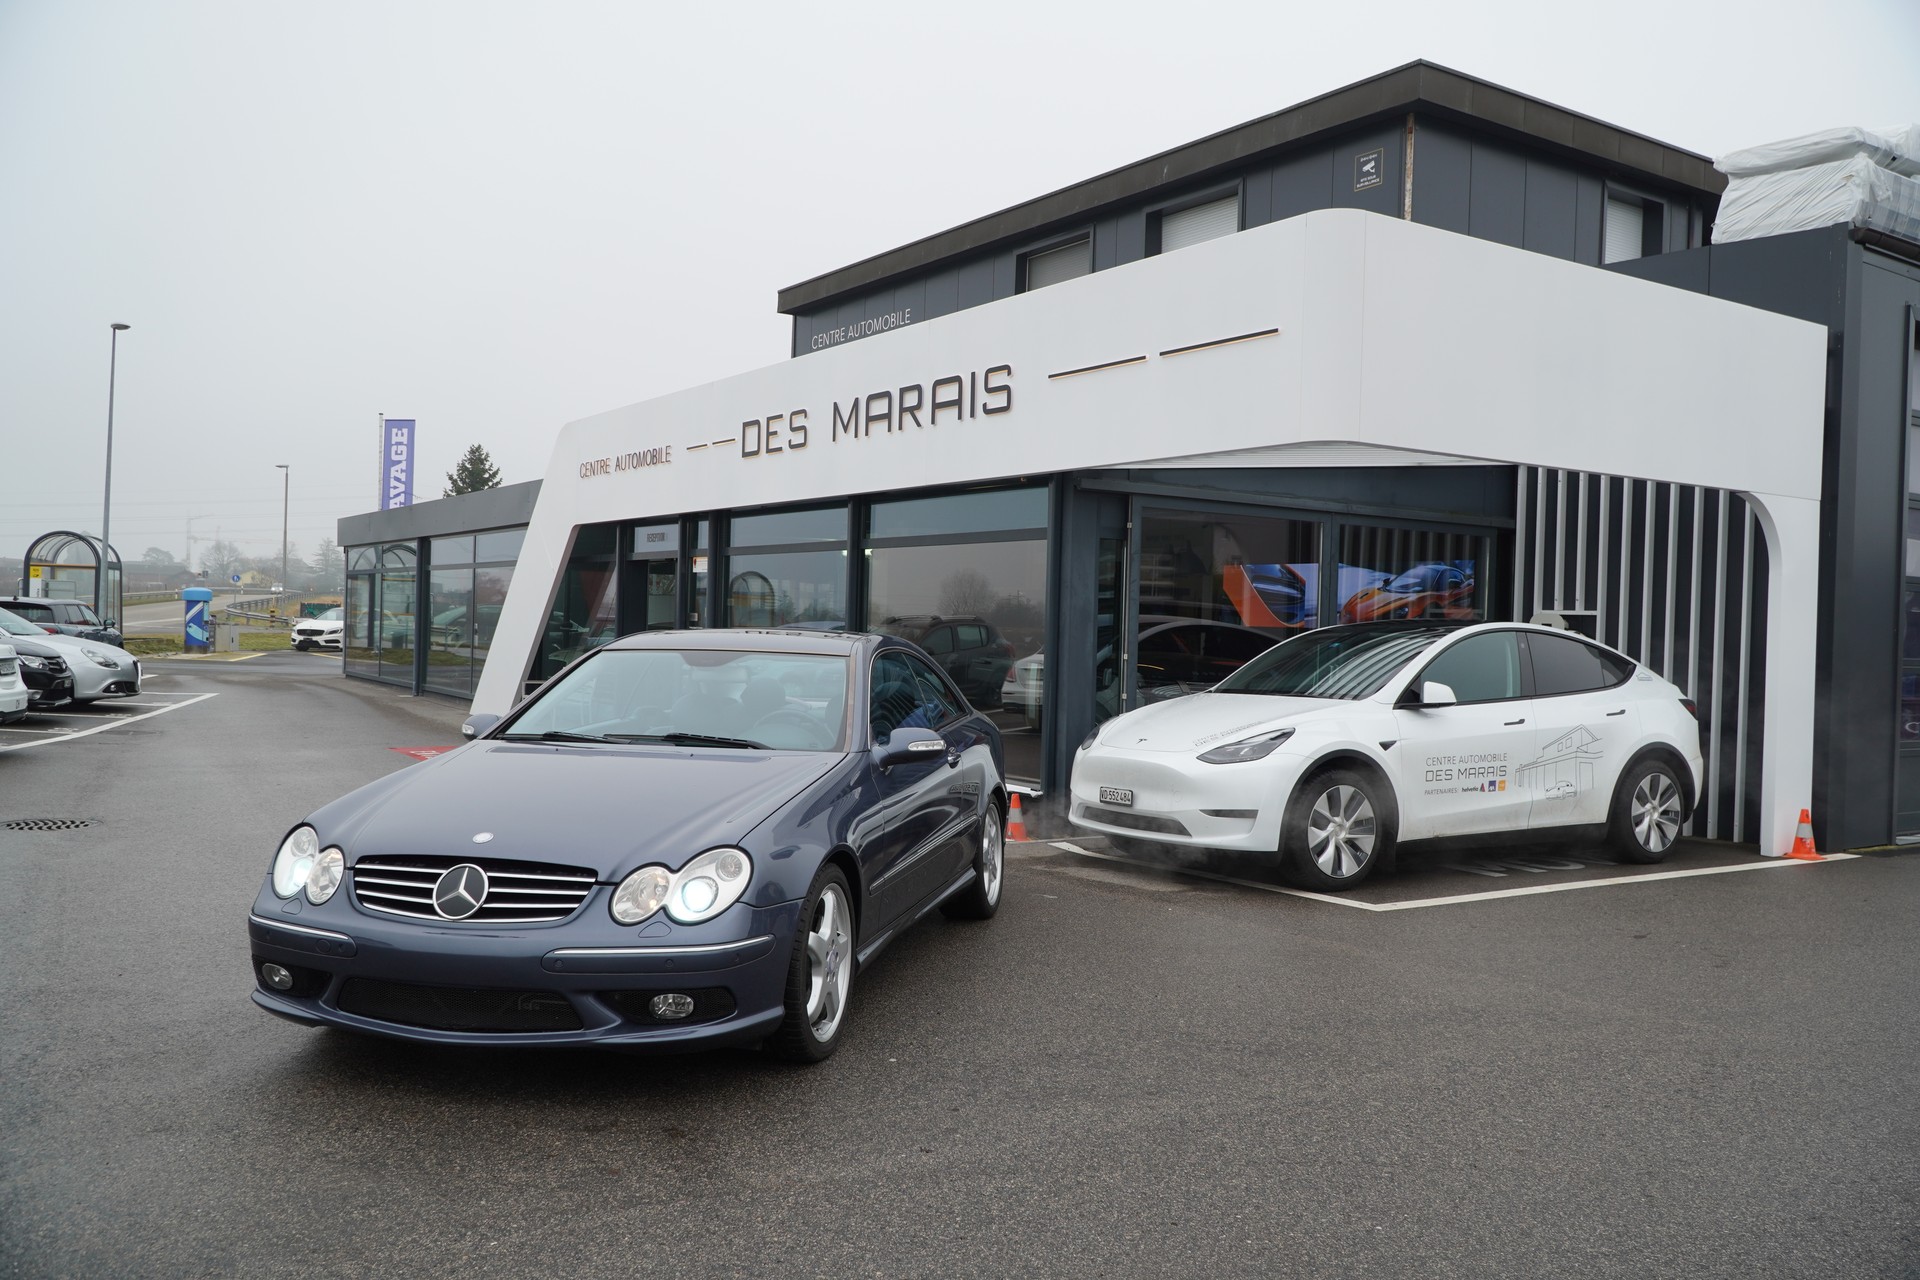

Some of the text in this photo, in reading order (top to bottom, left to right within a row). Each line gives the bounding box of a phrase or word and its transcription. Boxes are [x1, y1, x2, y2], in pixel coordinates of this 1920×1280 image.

[811, 308, 912, 350] CENTRE AUTOMOBILE
[579, 364, 1013, 479] CENTRE AUTOMOBILE DES MARAIS
[389, 428, 408, 509] AVAGE
[1425, 752, 1508, 767] CENTRE AUTOMOBILE
[1425, 765, 1507, 782] DES MARAIS
